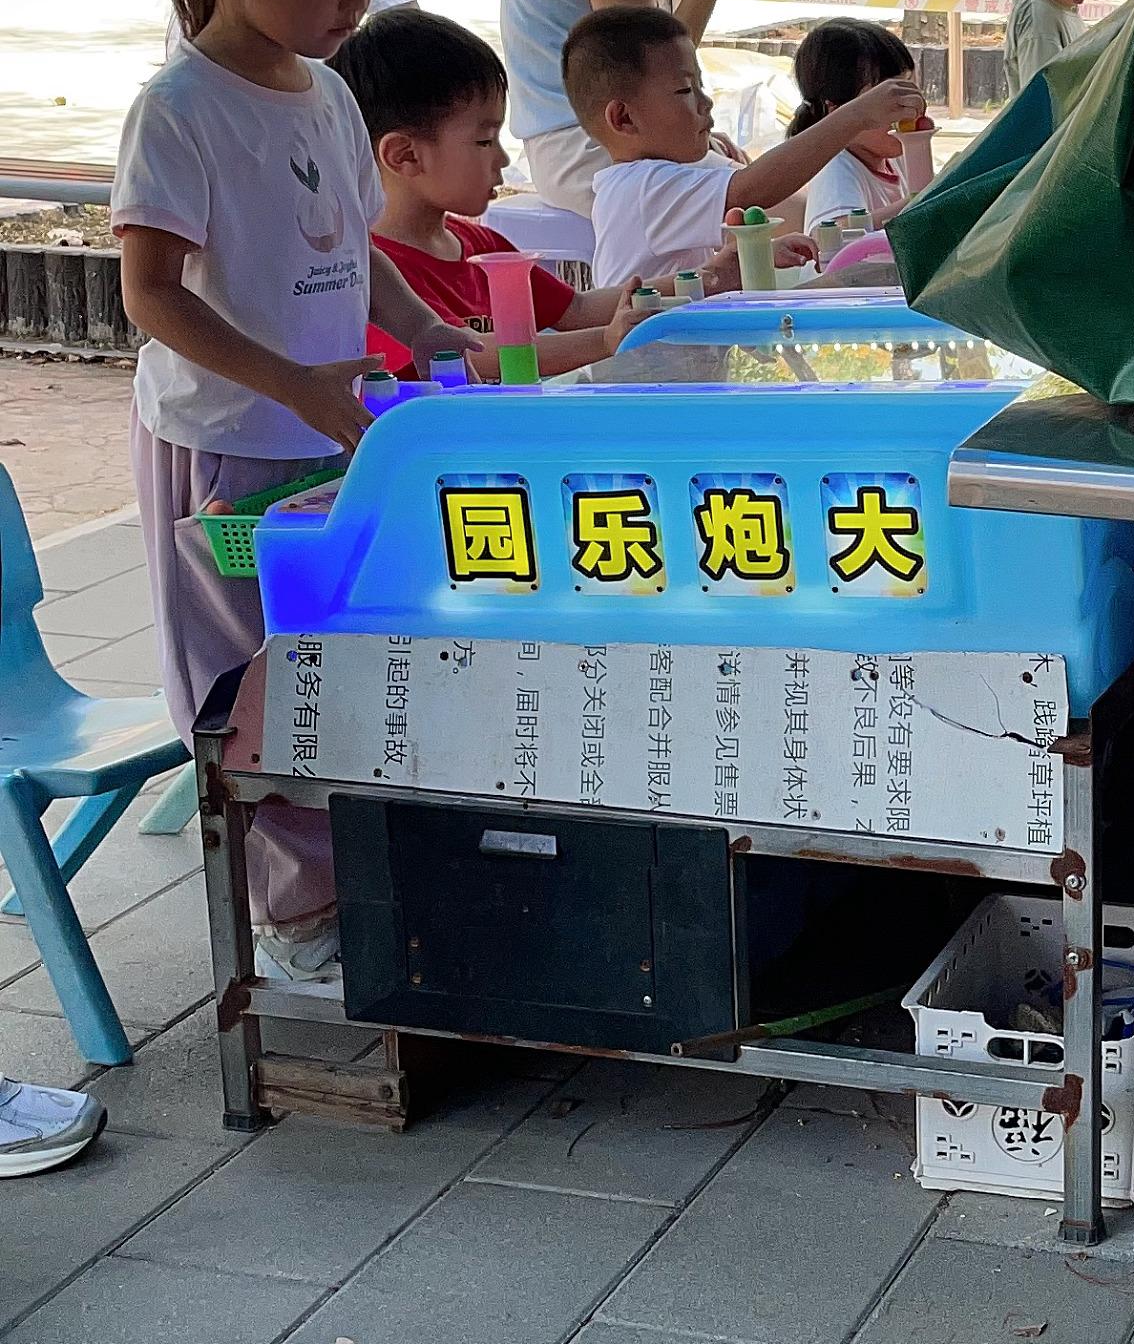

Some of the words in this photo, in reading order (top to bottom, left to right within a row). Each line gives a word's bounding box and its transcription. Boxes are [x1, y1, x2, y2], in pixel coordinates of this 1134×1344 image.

[293, 278, 349, 296] Summer
[291, 634, 323, 778] 服务有限
[647, 644, 675, 812] 客配合并服从
[885, 655, 916, 833] 等设有要求限
